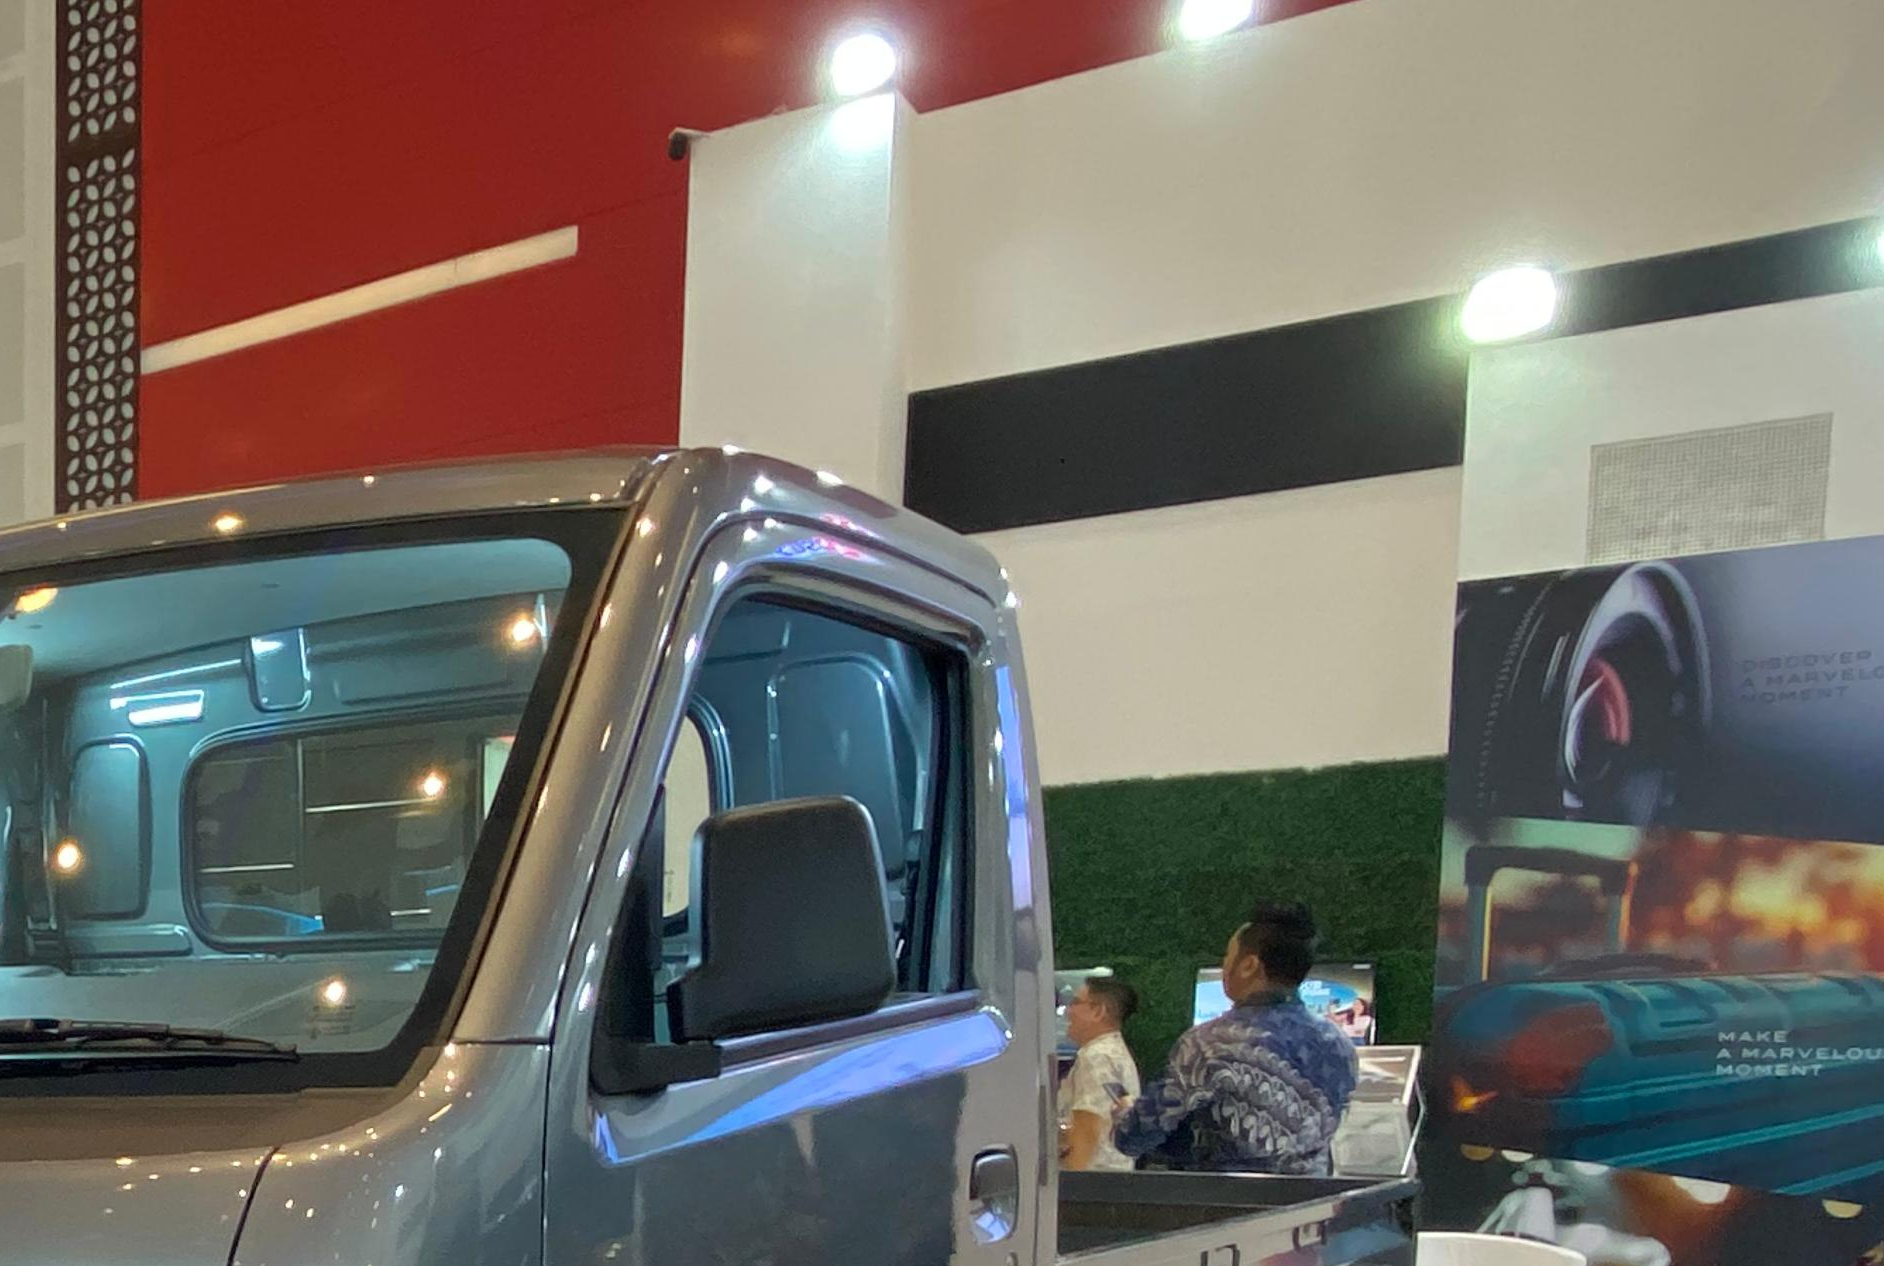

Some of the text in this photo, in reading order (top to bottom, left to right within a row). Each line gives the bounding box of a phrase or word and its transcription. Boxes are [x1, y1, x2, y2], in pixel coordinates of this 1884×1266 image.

[1742, 650, 1873, 673] DISCOVER
[1741, 677, 1756, 690] A
[1718, 1030, 1789, 1043] MAKE
[1716, 1047, 1884, 1060] A MARVELOU
[1716, 1063, 1823, 1077] MOMENT
